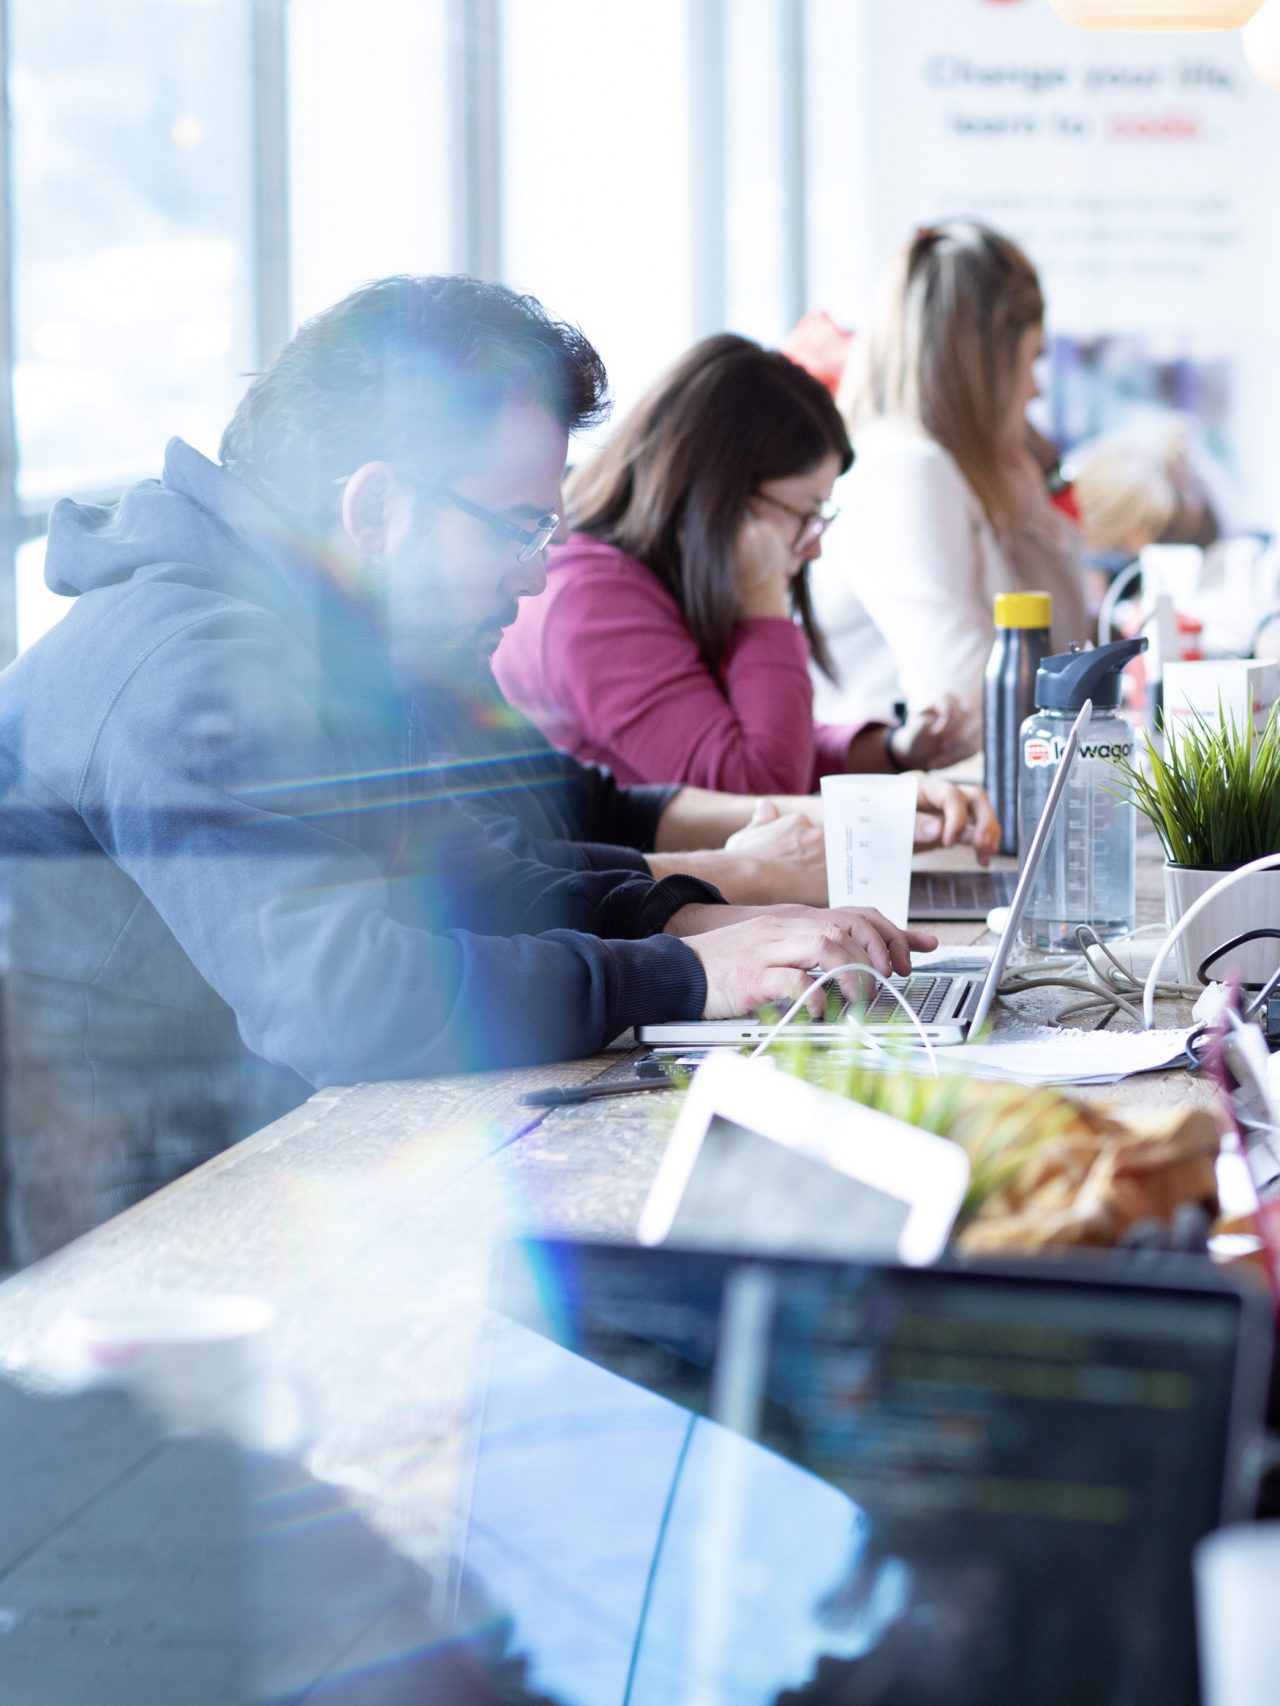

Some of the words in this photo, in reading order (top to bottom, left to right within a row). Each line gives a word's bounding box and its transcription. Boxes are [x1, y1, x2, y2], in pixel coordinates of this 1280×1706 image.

[925, 54, 1066, 94] Change
[1084, 66, 1158, 97] your
[949, 110, 1037, 138] learn
[1052, 112, 1087, 138] to
